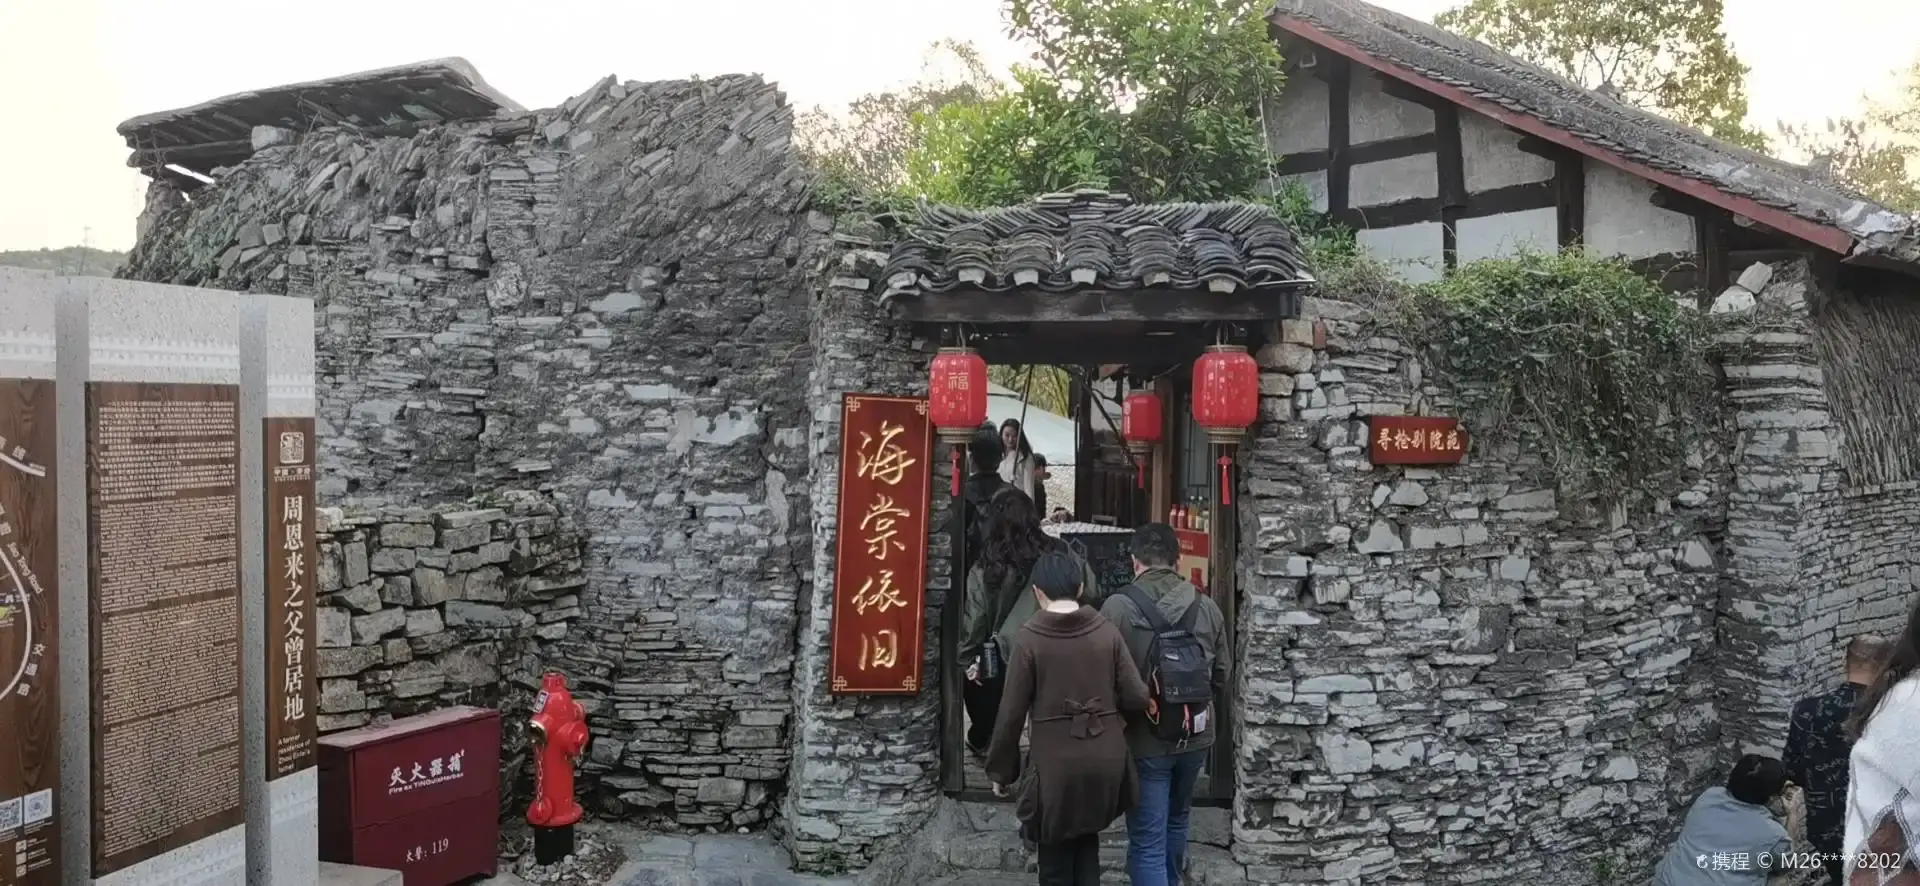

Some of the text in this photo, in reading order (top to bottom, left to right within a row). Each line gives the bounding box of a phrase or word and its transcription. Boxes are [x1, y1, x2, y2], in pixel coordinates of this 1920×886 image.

[948, 372, 968, 390] 福
[283, 495, 305, 721] 周恩来之父曾居地
[852, 420, 916, 671] 海棠依旧
[388, 749, 465, 787] 灭火器箱
